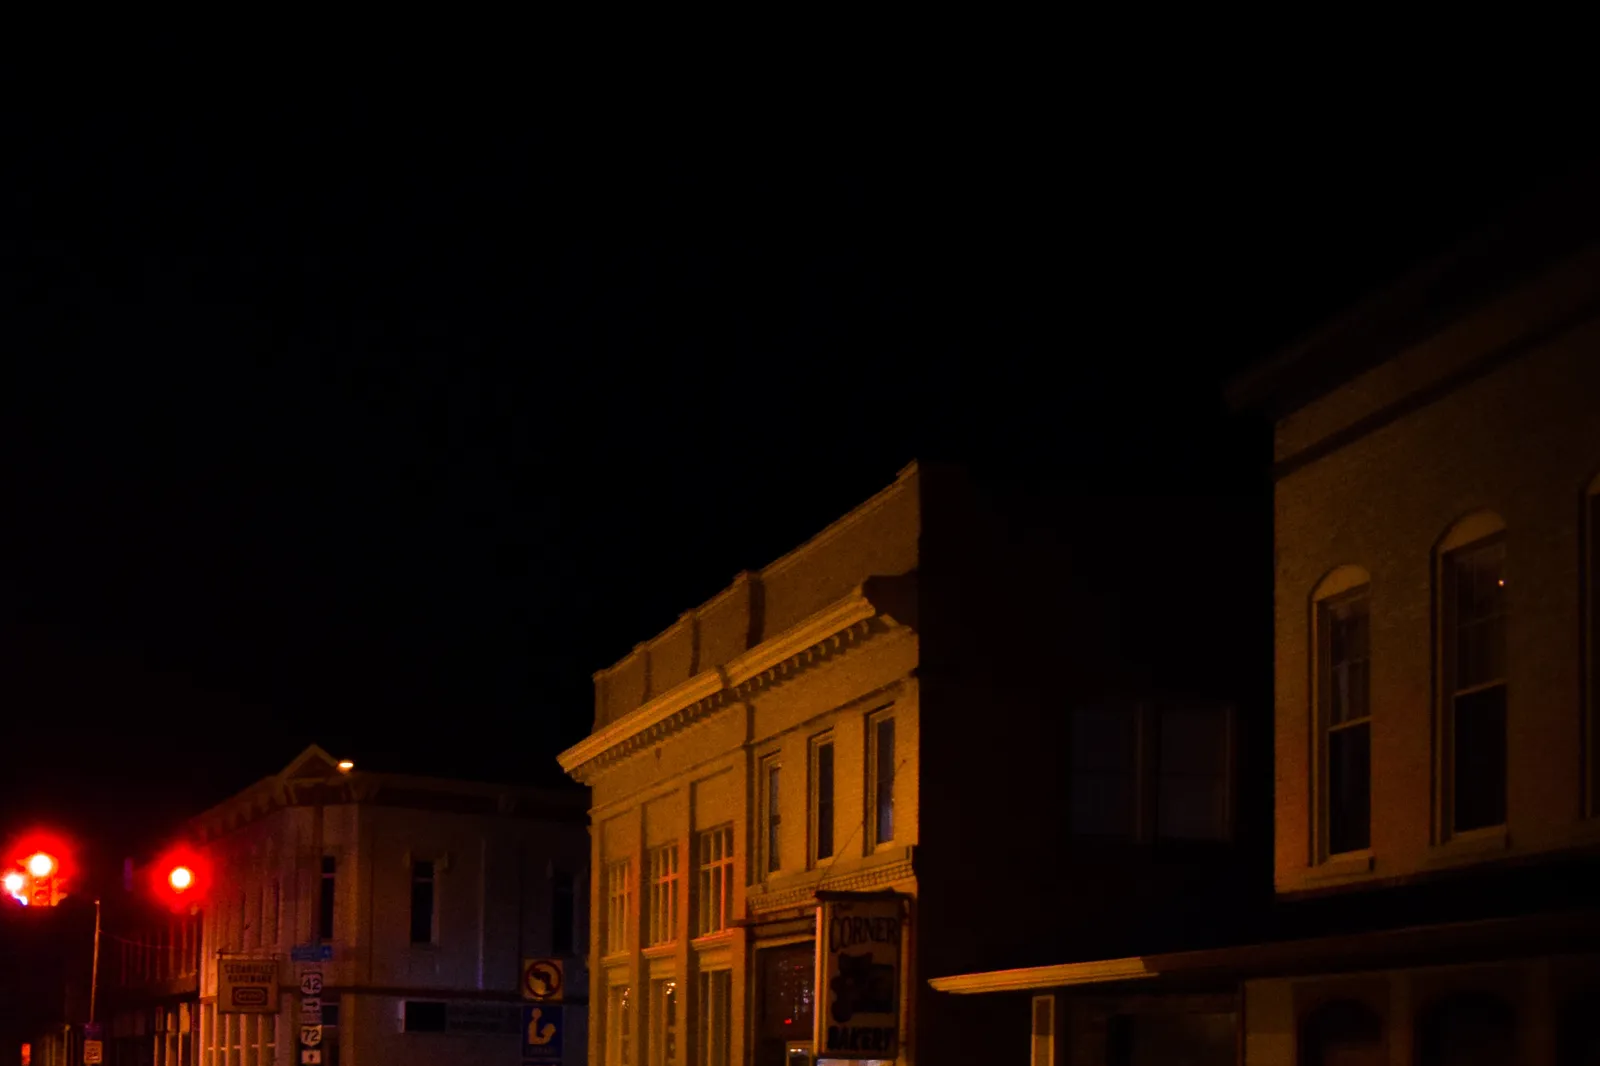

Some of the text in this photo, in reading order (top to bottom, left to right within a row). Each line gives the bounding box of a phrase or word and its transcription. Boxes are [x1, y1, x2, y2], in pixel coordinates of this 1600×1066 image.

[830, 916, 898, 952] CORNER
[302, 978, 323, 991] 42
[302, 1029, 320, 1042] 72
[827, 1025, 895, 1051] BAKERY
